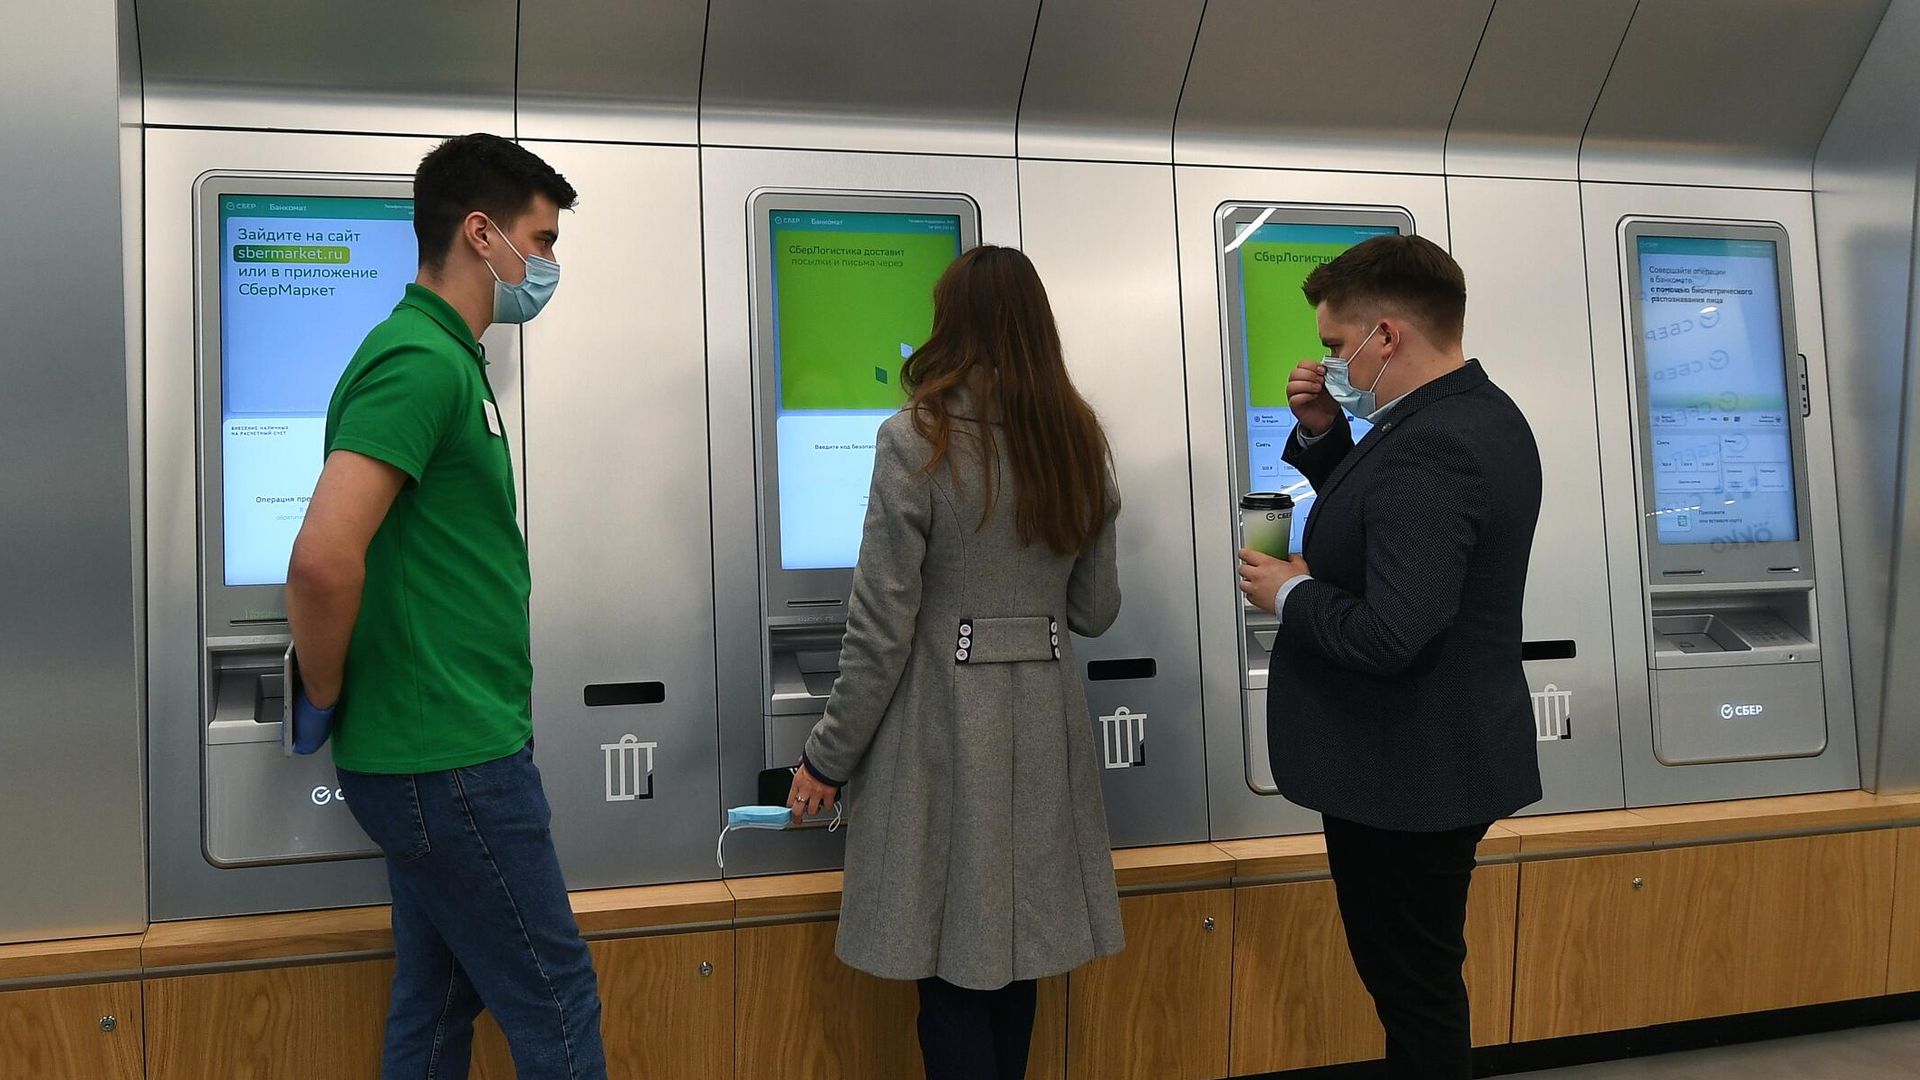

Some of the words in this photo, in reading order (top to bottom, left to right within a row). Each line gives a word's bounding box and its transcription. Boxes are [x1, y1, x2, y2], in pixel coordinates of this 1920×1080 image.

[269, 203, 307, 211] Банкомат
[811, 217, 843, 225] Банкомат
[238, 227, 302, 242] Зайдите
[306, 231, 323, 241] на
[328, 229, 360, 242] сайт
[238, 246, 343, 260] sbermarket.ru
[789, 245, 862, 255] СберЛогистика
[864, 248, 904, 256] доставит
[791, 258, 832, 266] посылки
[842, 259, 875, 267] письма
[877, 260, 904, 268] через
[1254, 251, 1335, 264] СберЛогисти
[238, 267, 267, 277] или
[271, 268, 279, 277] в
[284, 268, 378, 279] приложение
[238, 283, 336, 298] СберМаркет
[255, 496, 295, 504] Операция
[1735, 704, 1763, 716] СБЕР
